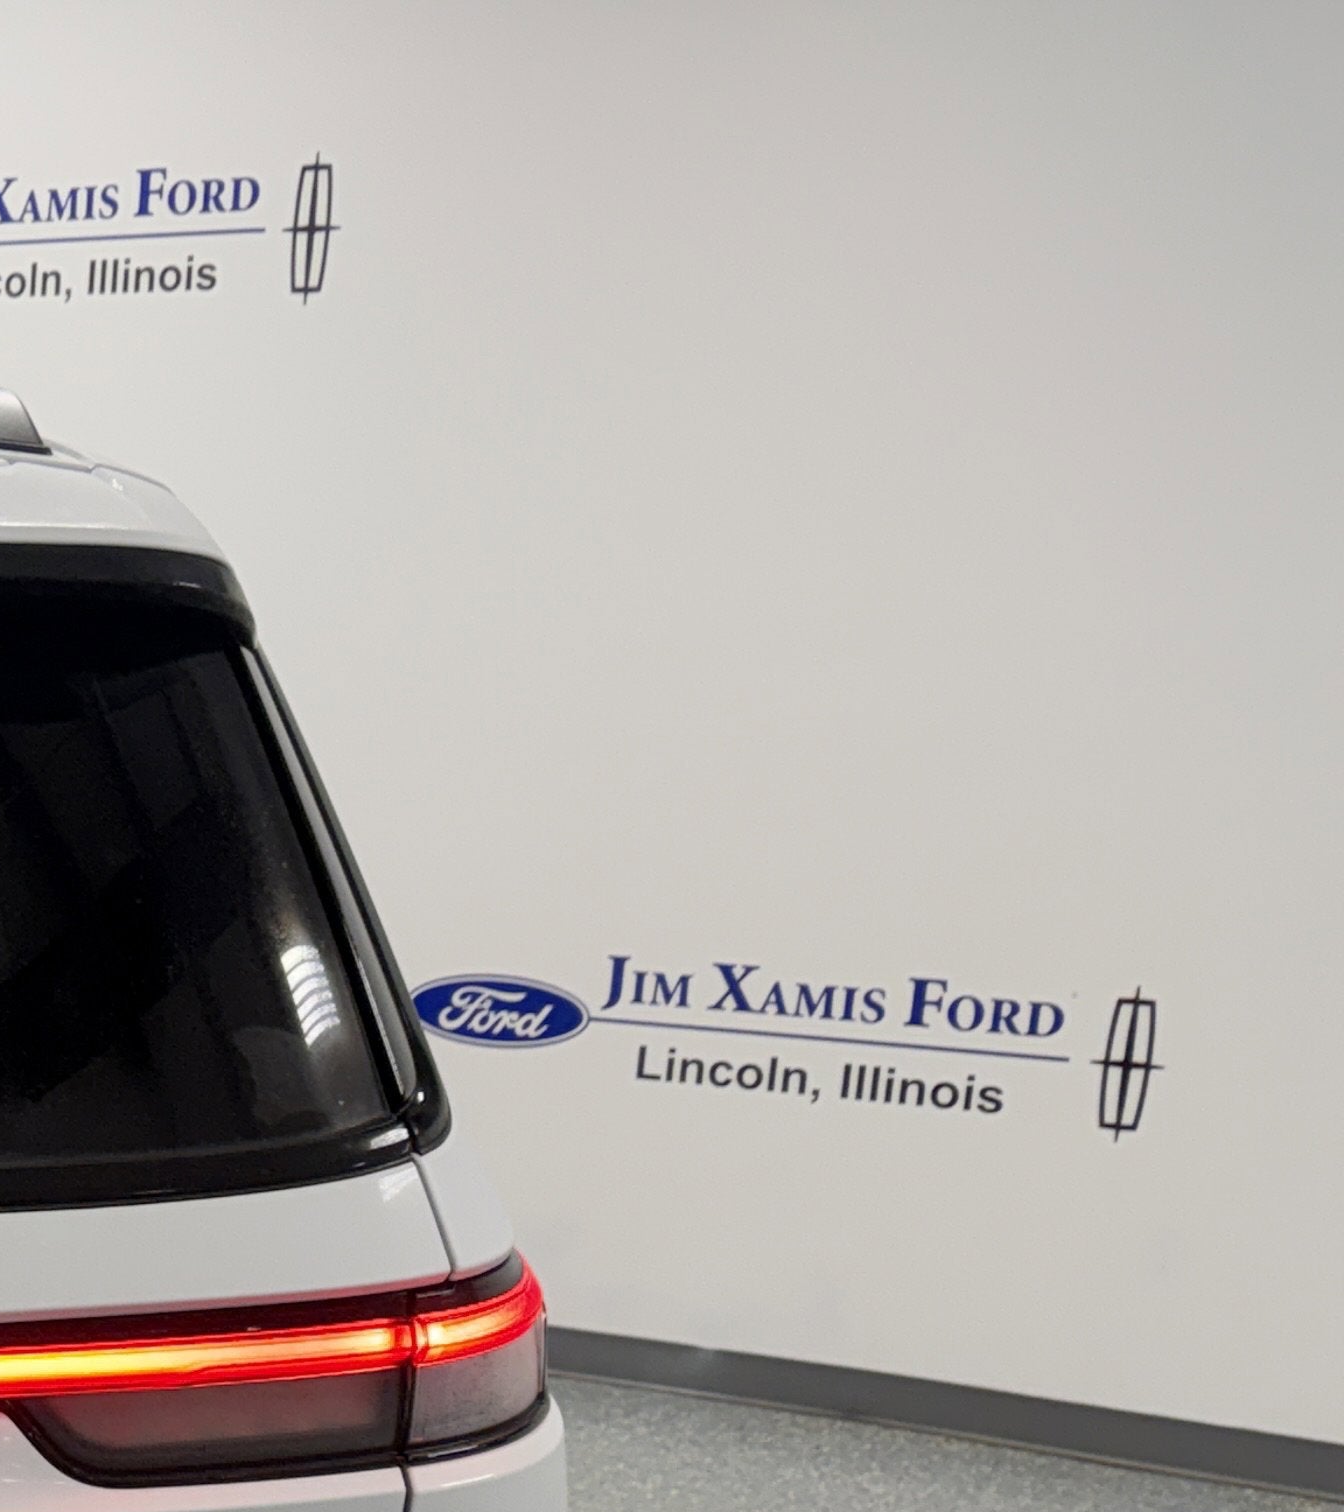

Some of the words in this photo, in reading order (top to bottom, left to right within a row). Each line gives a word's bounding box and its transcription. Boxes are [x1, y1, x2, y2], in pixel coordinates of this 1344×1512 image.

[134, 167, 262, 218] FORD
[87, 255, 218, 296] Illinois
[436, 987, 549, 1040] Ford
[600, 954, 693, 1011] JIM
[707, 962, 888, 1025] XAMIS
[904, 976, 1066, 1039] FORD
[635, 1045, 823, 1103] Lincoln,
[839, 1063, 1005, 1115] Illinois
